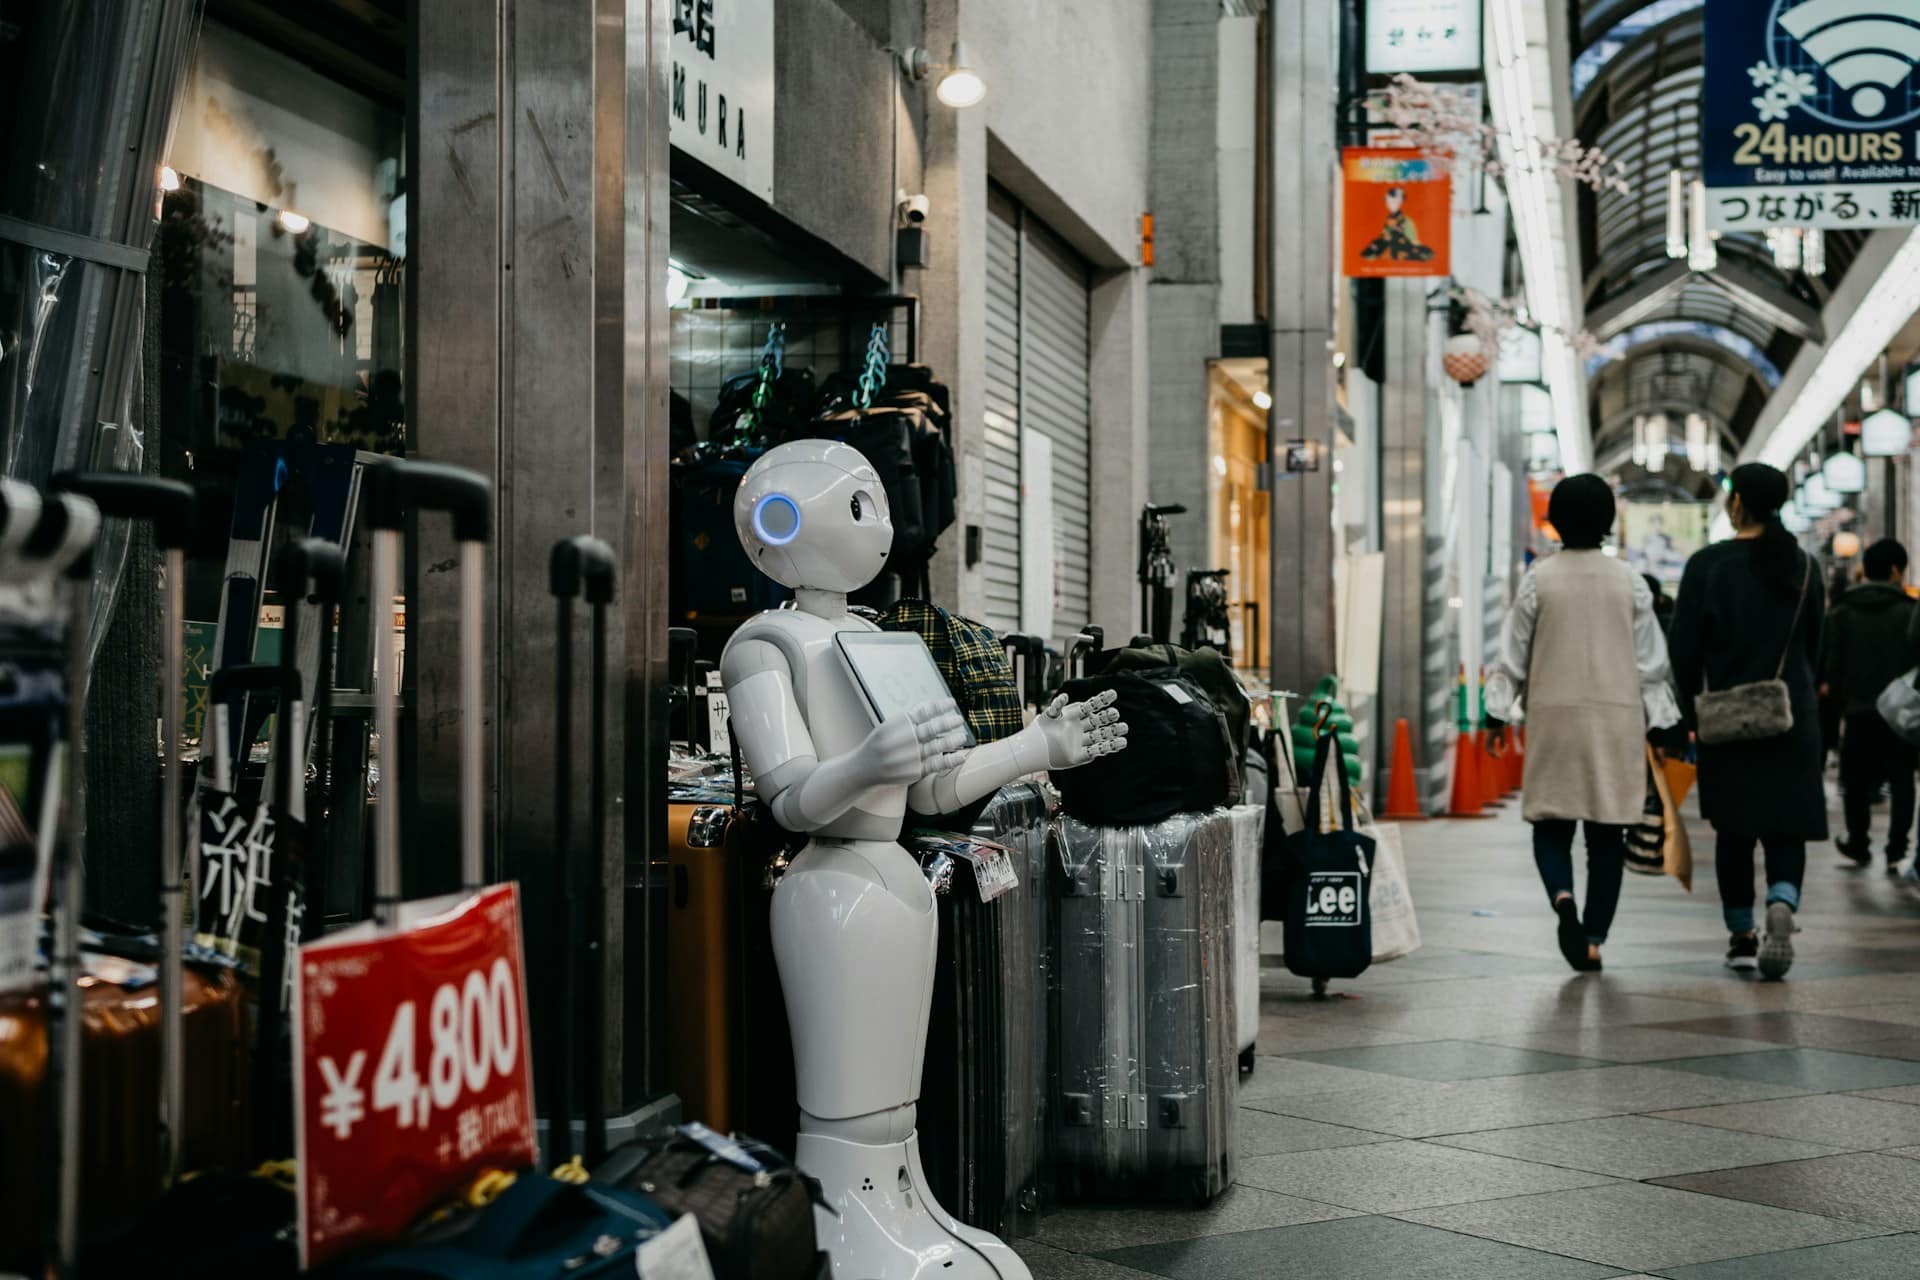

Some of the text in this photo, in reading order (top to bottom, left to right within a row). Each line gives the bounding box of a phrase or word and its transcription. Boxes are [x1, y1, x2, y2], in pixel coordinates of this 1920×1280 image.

[1755, 167, 1786, 184] Easy
[1789, 168, 1804, 181] to
[1841, 164, 1906, 179] Available
[1306, 885, 1356, 914] Lee
[318, 957, 518, 1139] ¥4,800
